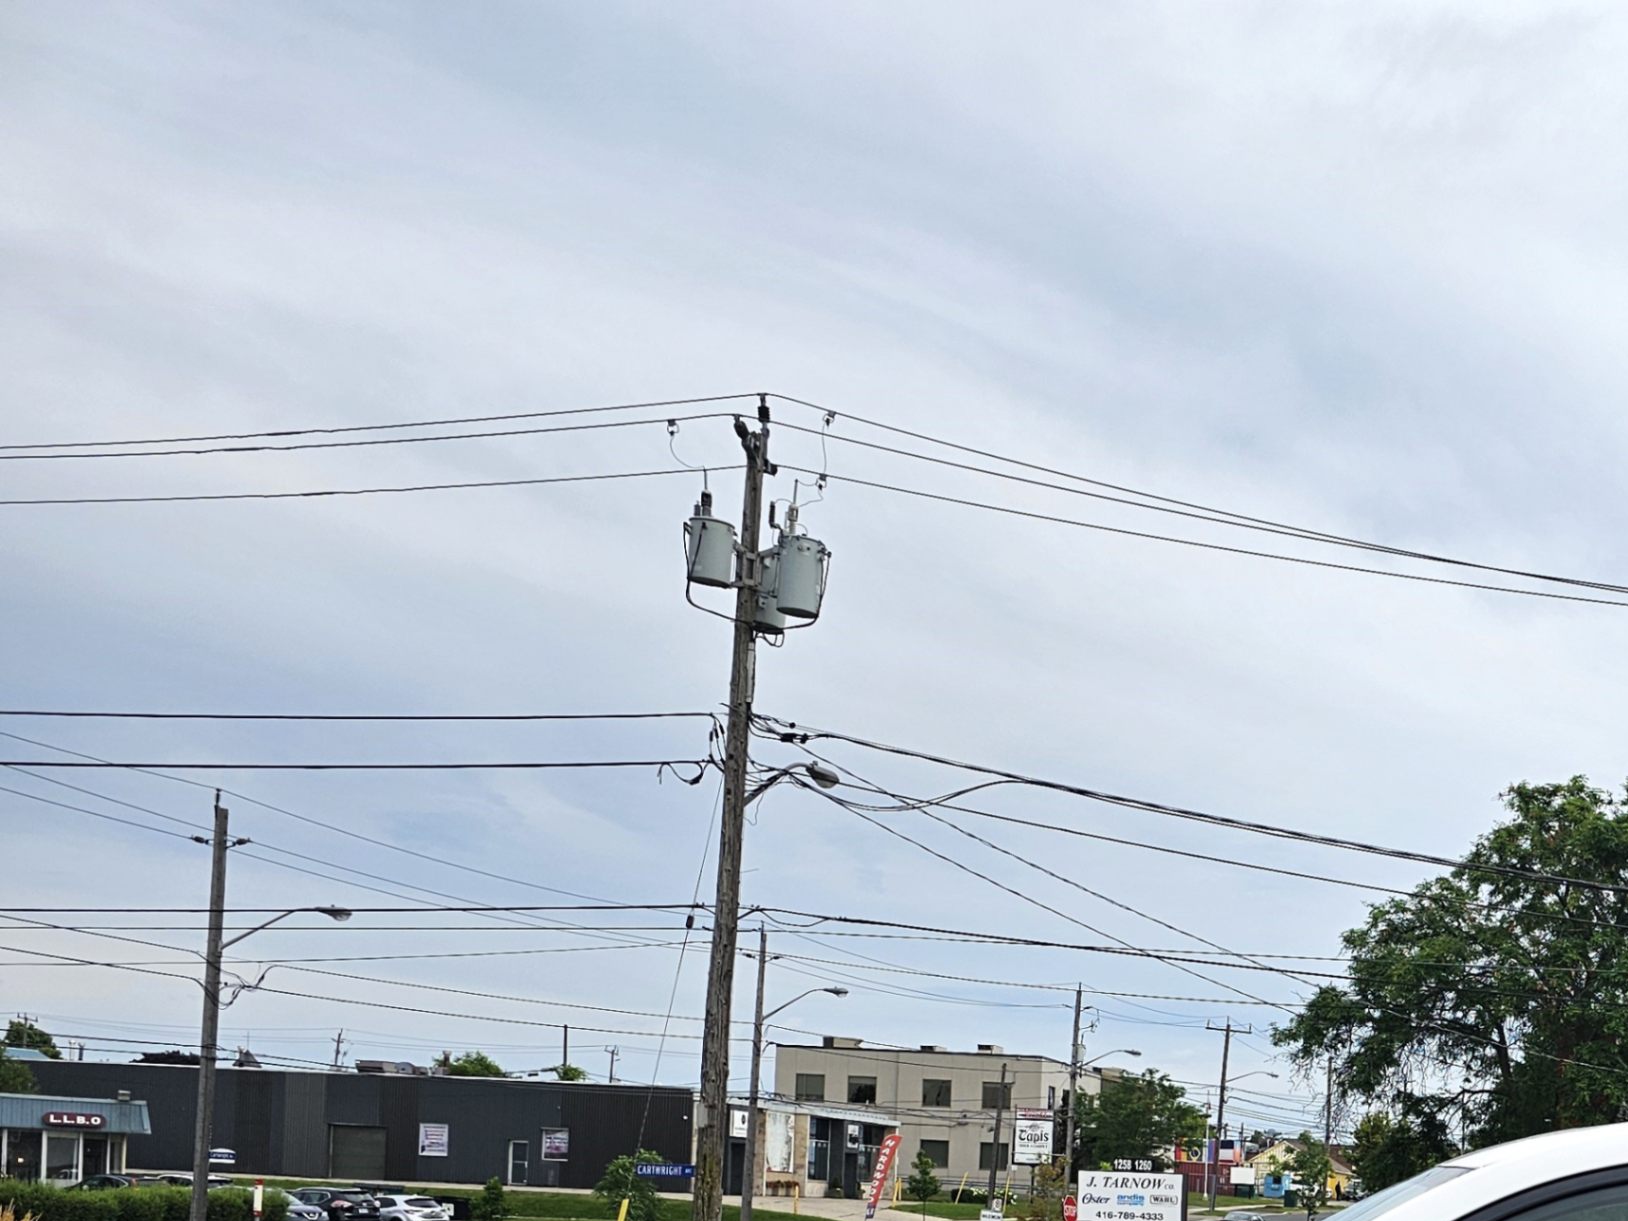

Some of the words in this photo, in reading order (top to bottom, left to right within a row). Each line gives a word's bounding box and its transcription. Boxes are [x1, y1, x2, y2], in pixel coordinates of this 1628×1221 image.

[1018, 1129, 1049, 1144] Tapis
[1114, 1159, 1132, 1170] 1258
[1135, 1160, 1152, 1170] 1260
[637, 1165, 682, 1176] CARTWRIGHT
[1086, 1176, 1097, 1188] J.
[1103, 1176, 1166, 1189] TARNOW
[1081, 1193, 1110, 1204] Oster
[1152, 1195, 1174, 1203] WAHL
[1095, 1211, 1164, 1221] 416-789-4333
